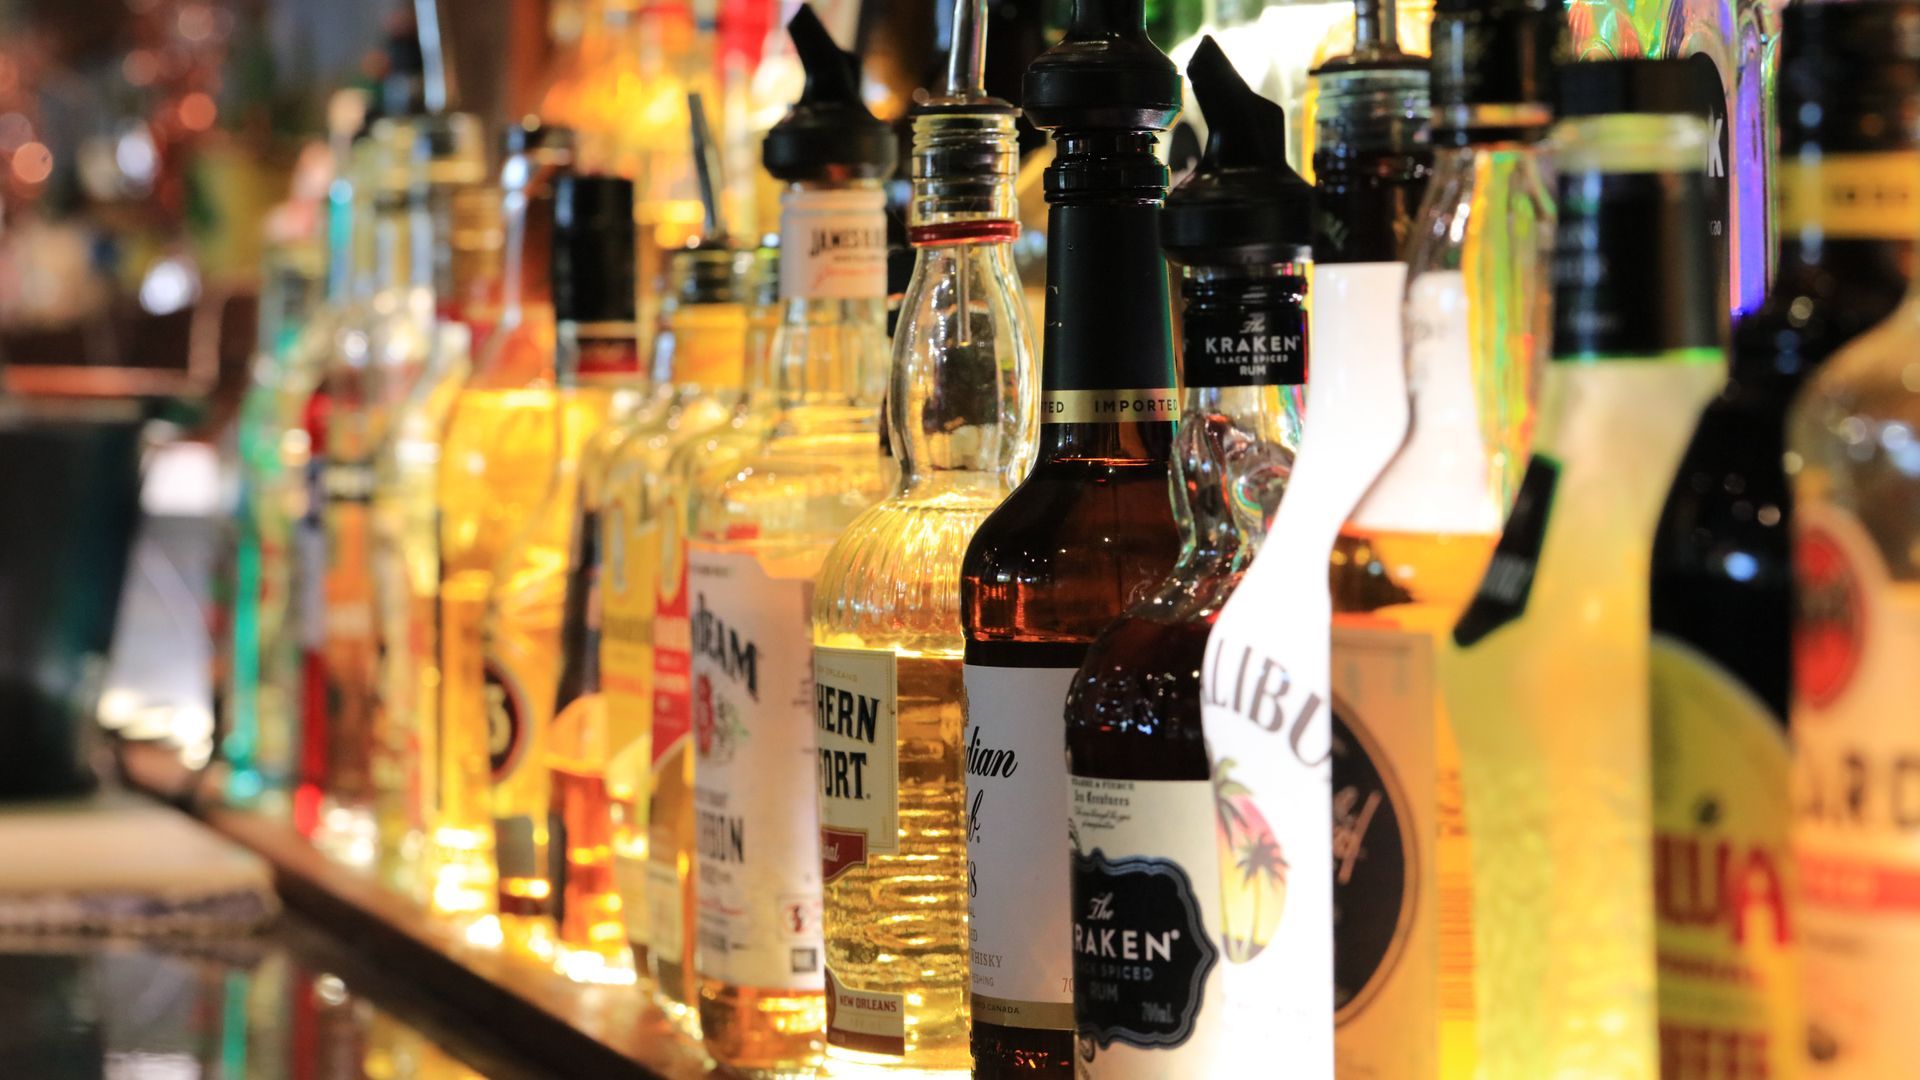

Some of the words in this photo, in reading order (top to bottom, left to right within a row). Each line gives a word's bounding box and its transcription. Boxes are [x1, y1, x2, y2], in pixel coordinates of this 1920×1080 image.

[1205, 335, 1297, 354] KRAKEN
[1215, 355, 1249, 365] BLACK
[1253, 354, 1289, 364] SPICED
[1239, 365, 1267, 376] RUM
[1095, 399, 1178, 413] IMPORTED
[817, 682, 881, 744] HERN
[1086, 892, 1114, 920] The
[1074, 922, 1172, 962] RAKEN
[1101, 964, 1154, 981] SPICED
[1090, 980, 1119, 1003] RUM
[840, 994, 854, 1007] NEW
[855, 997, 897, 1012] ORLEANS
[988, 1002, 1020, 1015] CANADA
